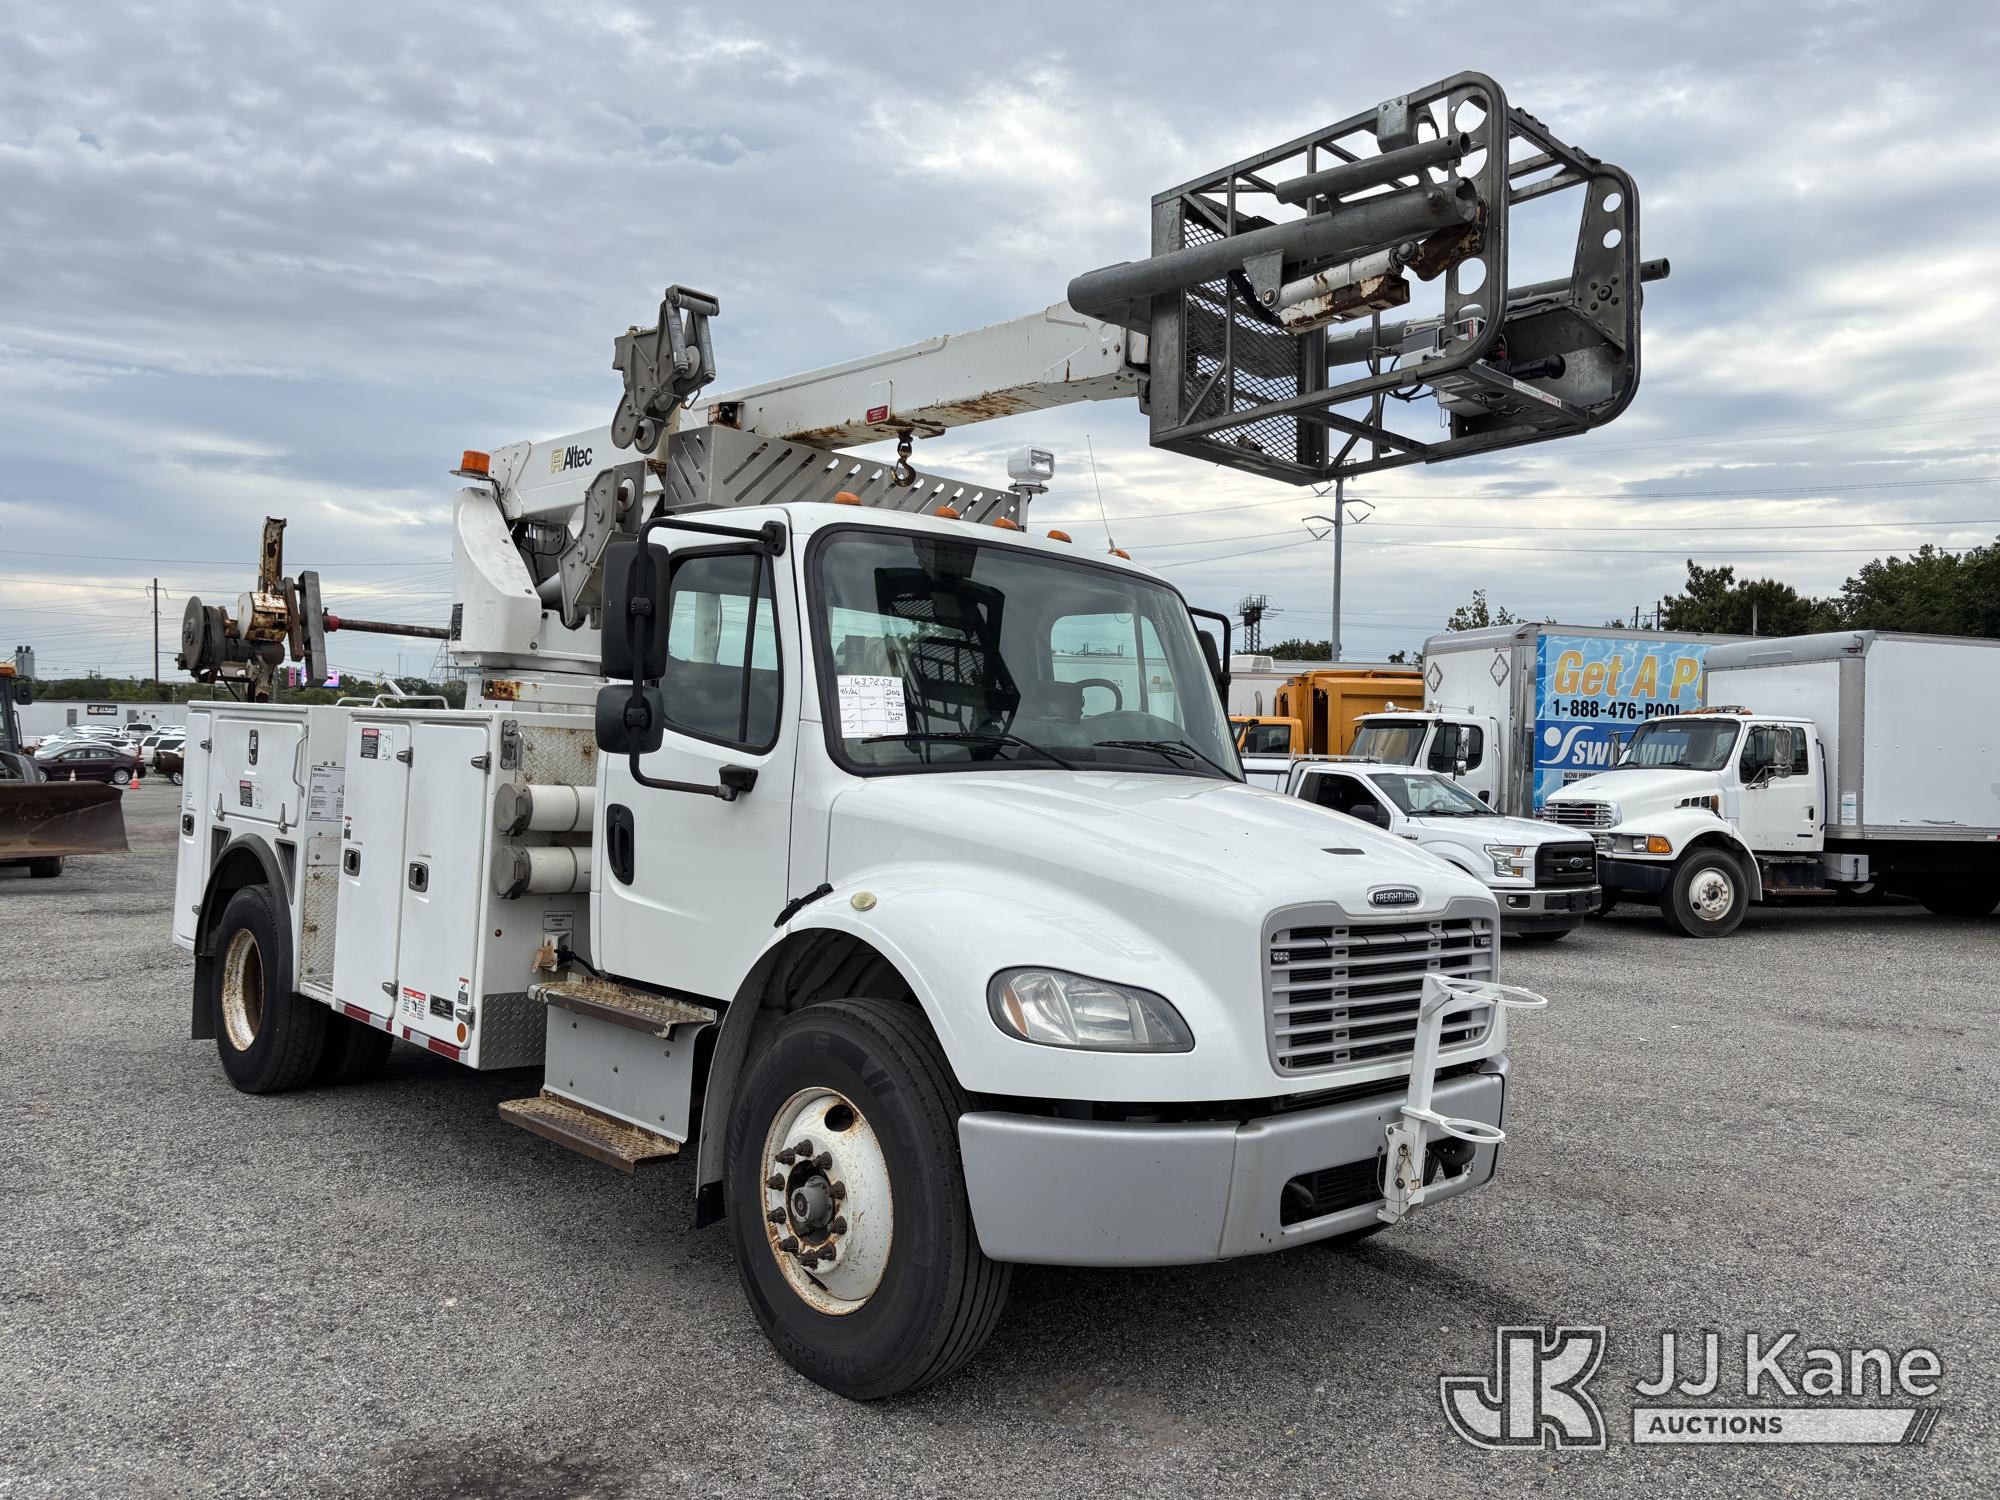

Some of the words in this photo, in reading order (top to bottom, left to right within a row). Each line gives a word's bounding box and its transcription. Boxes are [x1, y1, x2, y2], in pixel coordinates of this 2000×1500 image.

[562, 444, 593, 471] Altec
[1553, 650, 1623, 698] Get
[1629, 655, 1657, 699] A
[1668, 656, 1703, 701] P
[1564, 771, 1578, 779] NOW
